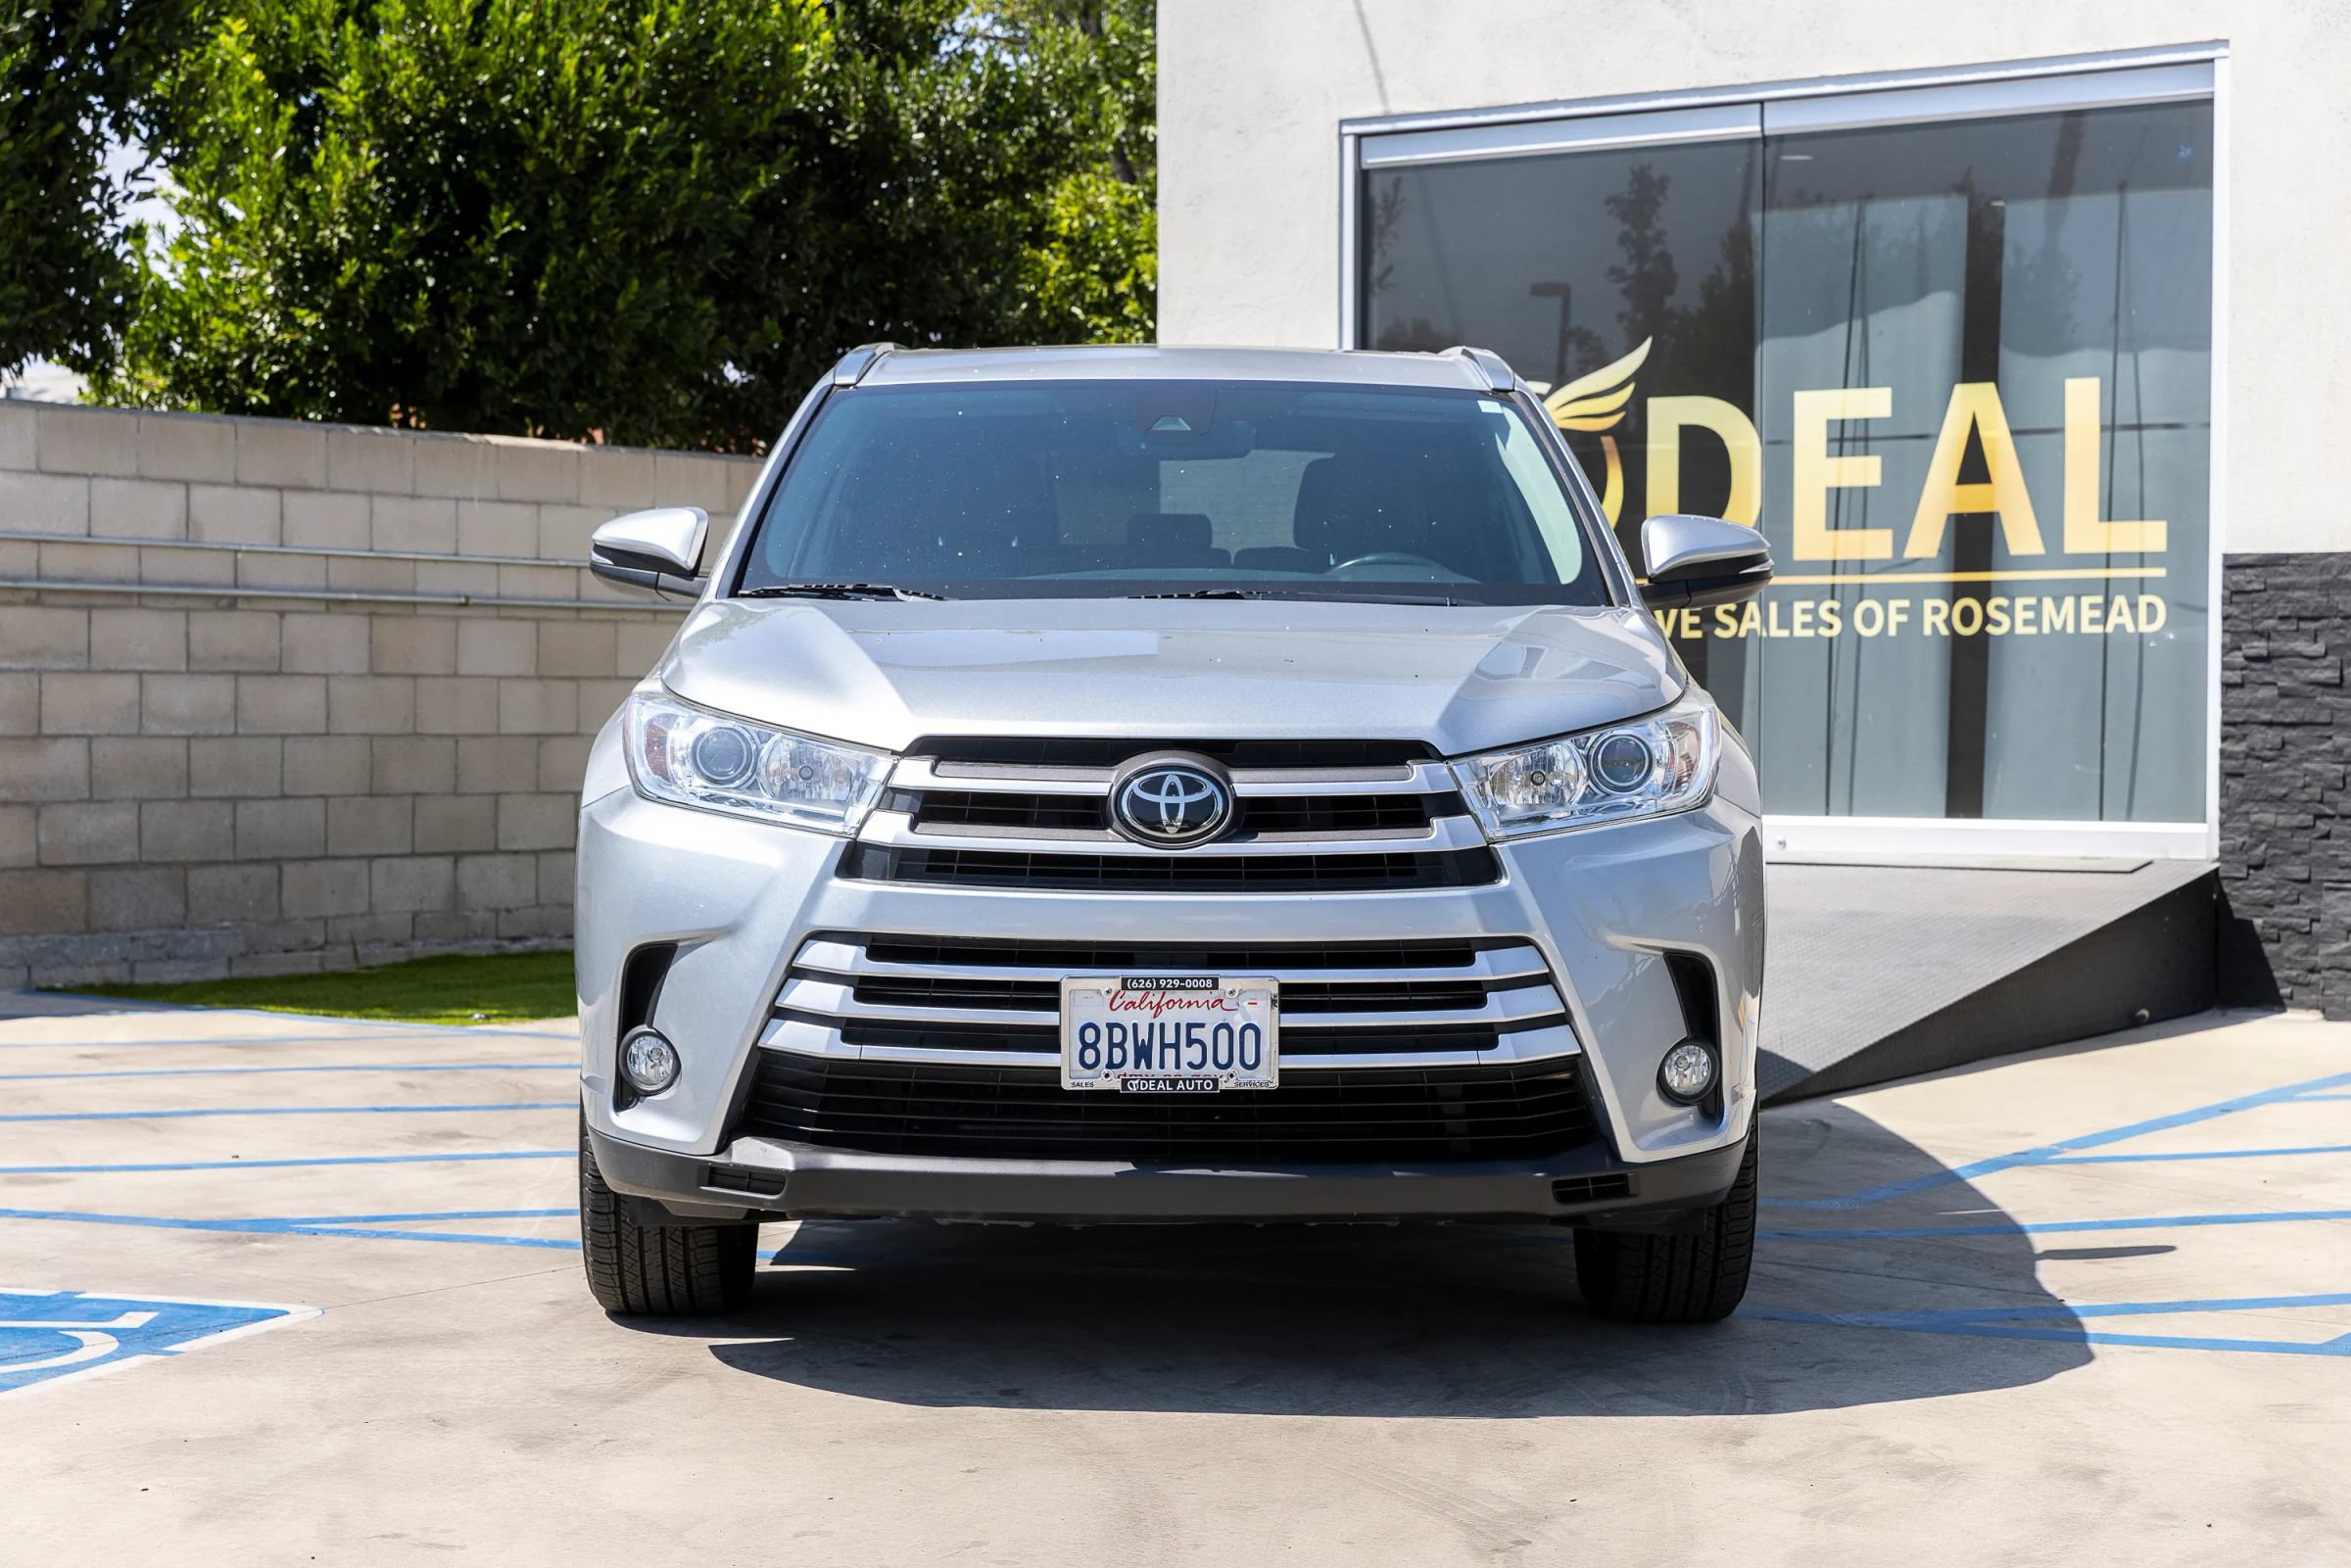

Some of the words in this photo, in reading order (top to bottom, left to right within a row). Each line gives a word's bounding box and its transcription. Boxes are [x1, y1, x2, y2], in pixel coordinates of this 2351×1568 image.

[1713, 598, 1843, 640] SALES
[1852, 598, 1911, 638] OF
[1922, 594, 2168, 637] ROSEMEAD
[1127, 977, 1157, 990] (626)
[1159, 978, 1213, 989] 929-0008
[1109, 990, 1238, 1019] California
[1079, 1022, 1262, 1070] 8BWH500
[1176, 1079, 1214, 1091] AUTO
